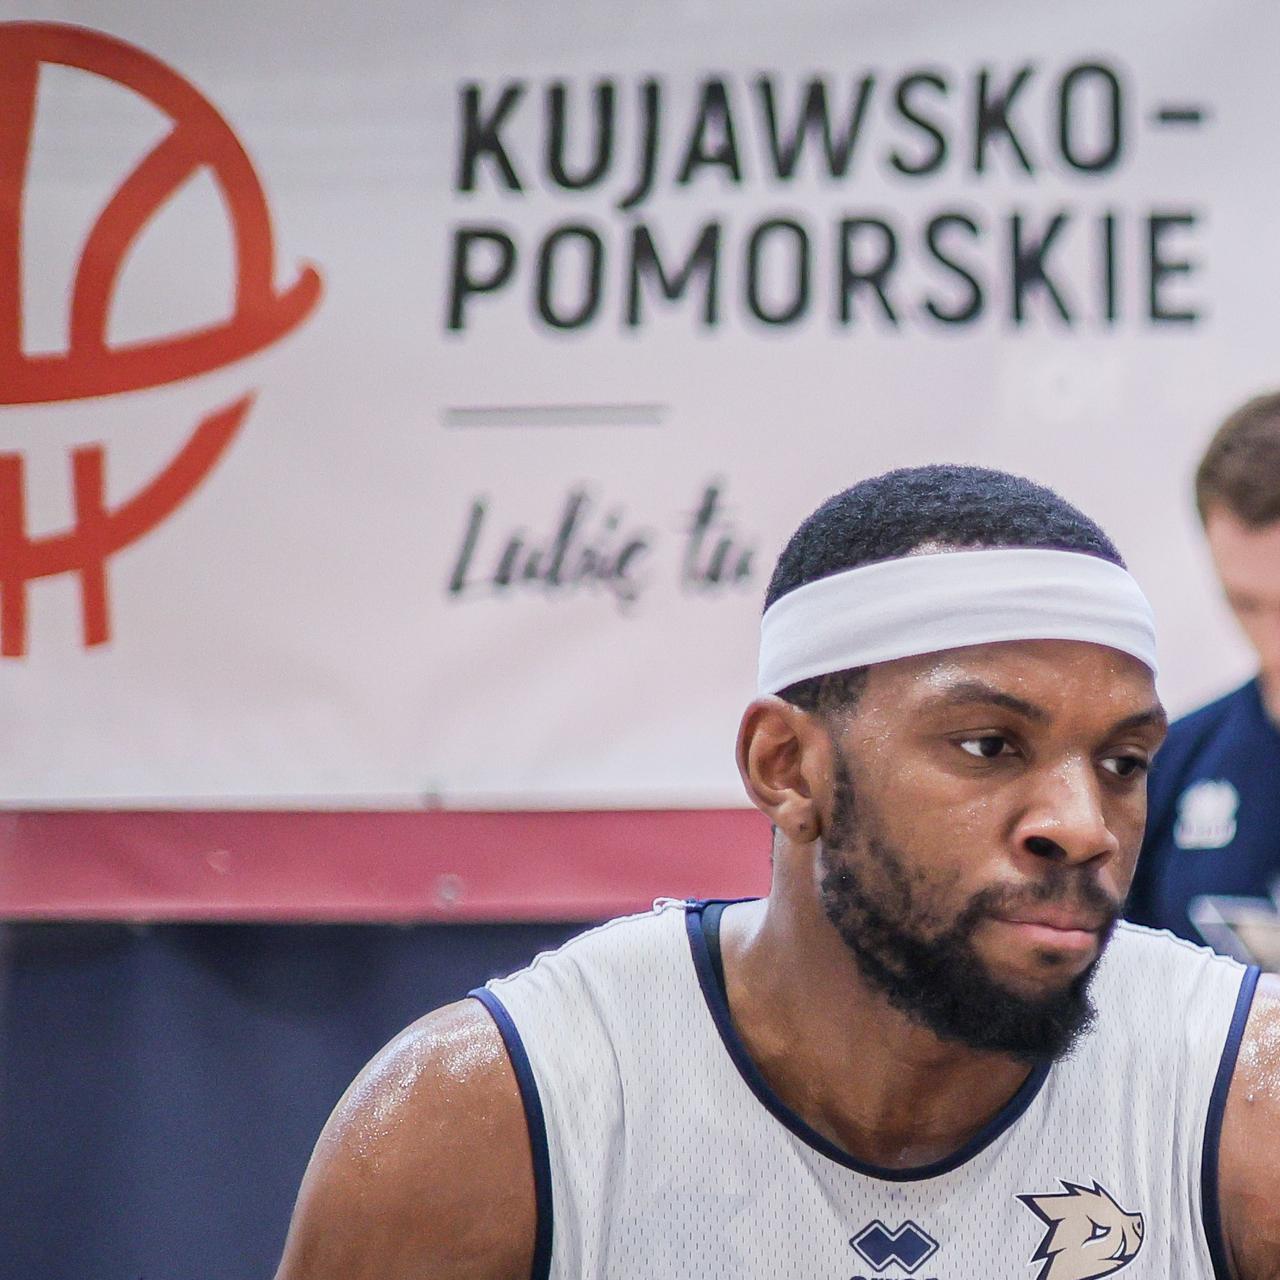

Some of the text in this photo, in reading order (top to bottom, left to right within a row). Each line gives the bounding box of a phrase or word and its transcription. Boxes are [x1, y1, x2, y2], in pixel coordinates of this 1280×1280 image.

[454, 62, 1206, 210] KUJAWSKO-
[443, 212, 1204, 332] POMORSKIE
[446, 486, 650, 612] Lubię
